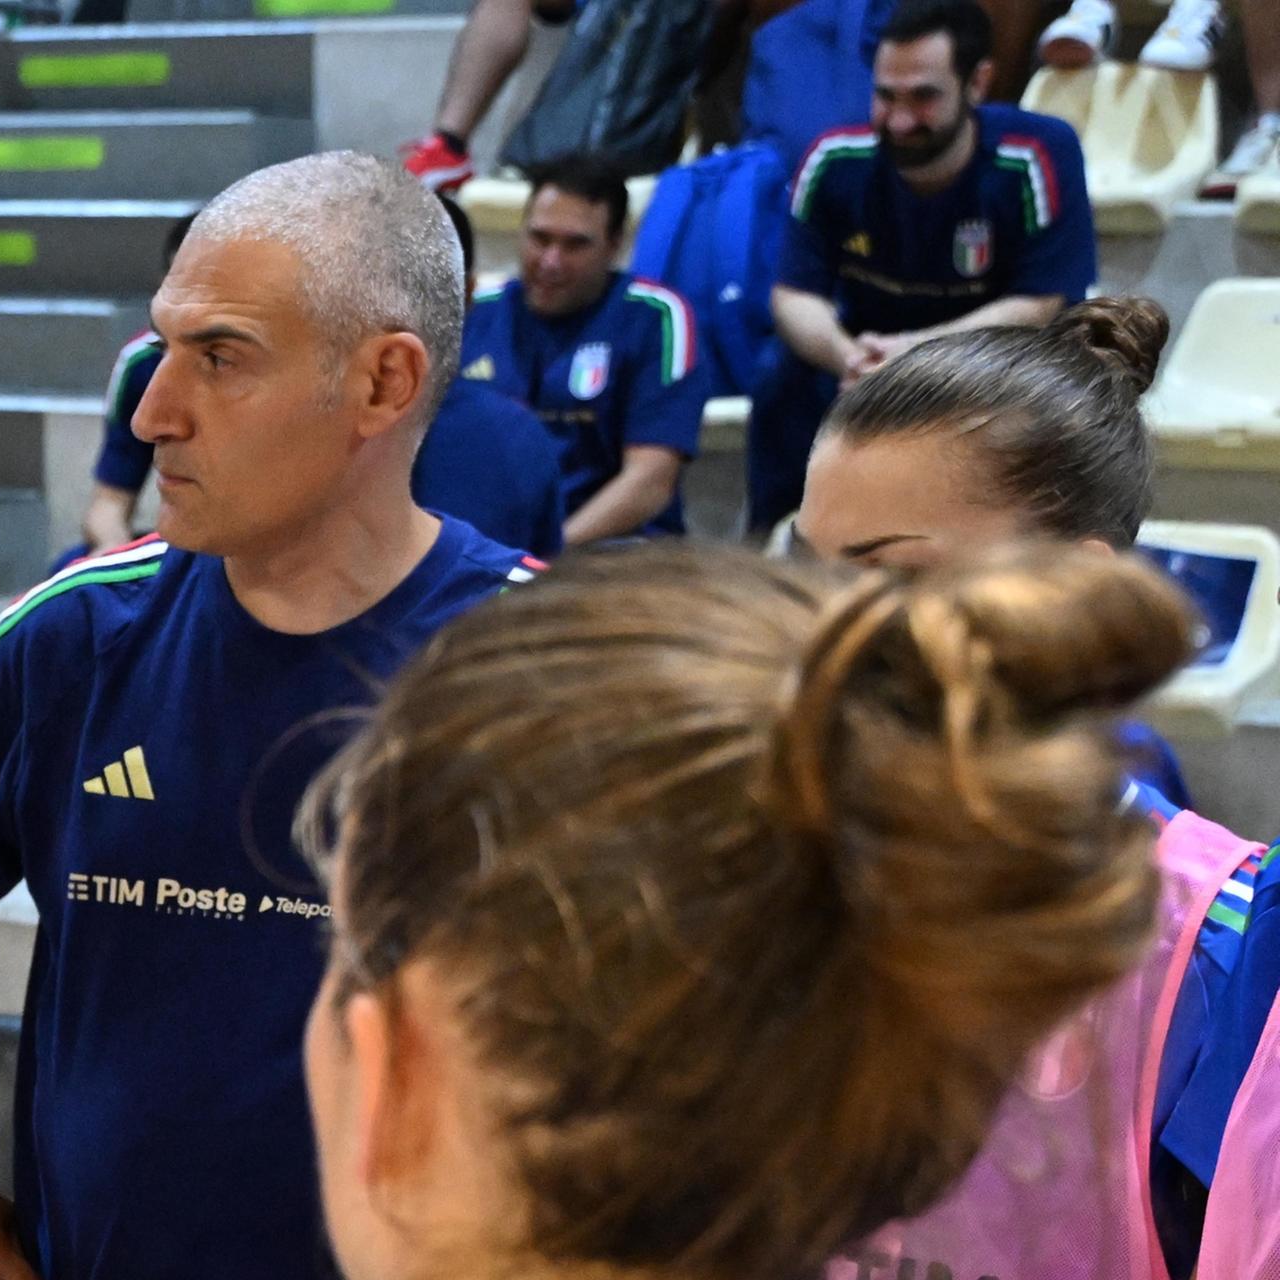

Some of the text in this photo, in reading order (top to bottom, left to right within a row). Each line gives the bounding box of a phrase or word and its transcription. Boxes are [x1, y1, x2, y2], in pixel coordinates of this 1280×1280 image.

[92, 875, 336, 920] TIM Poste Telepa
